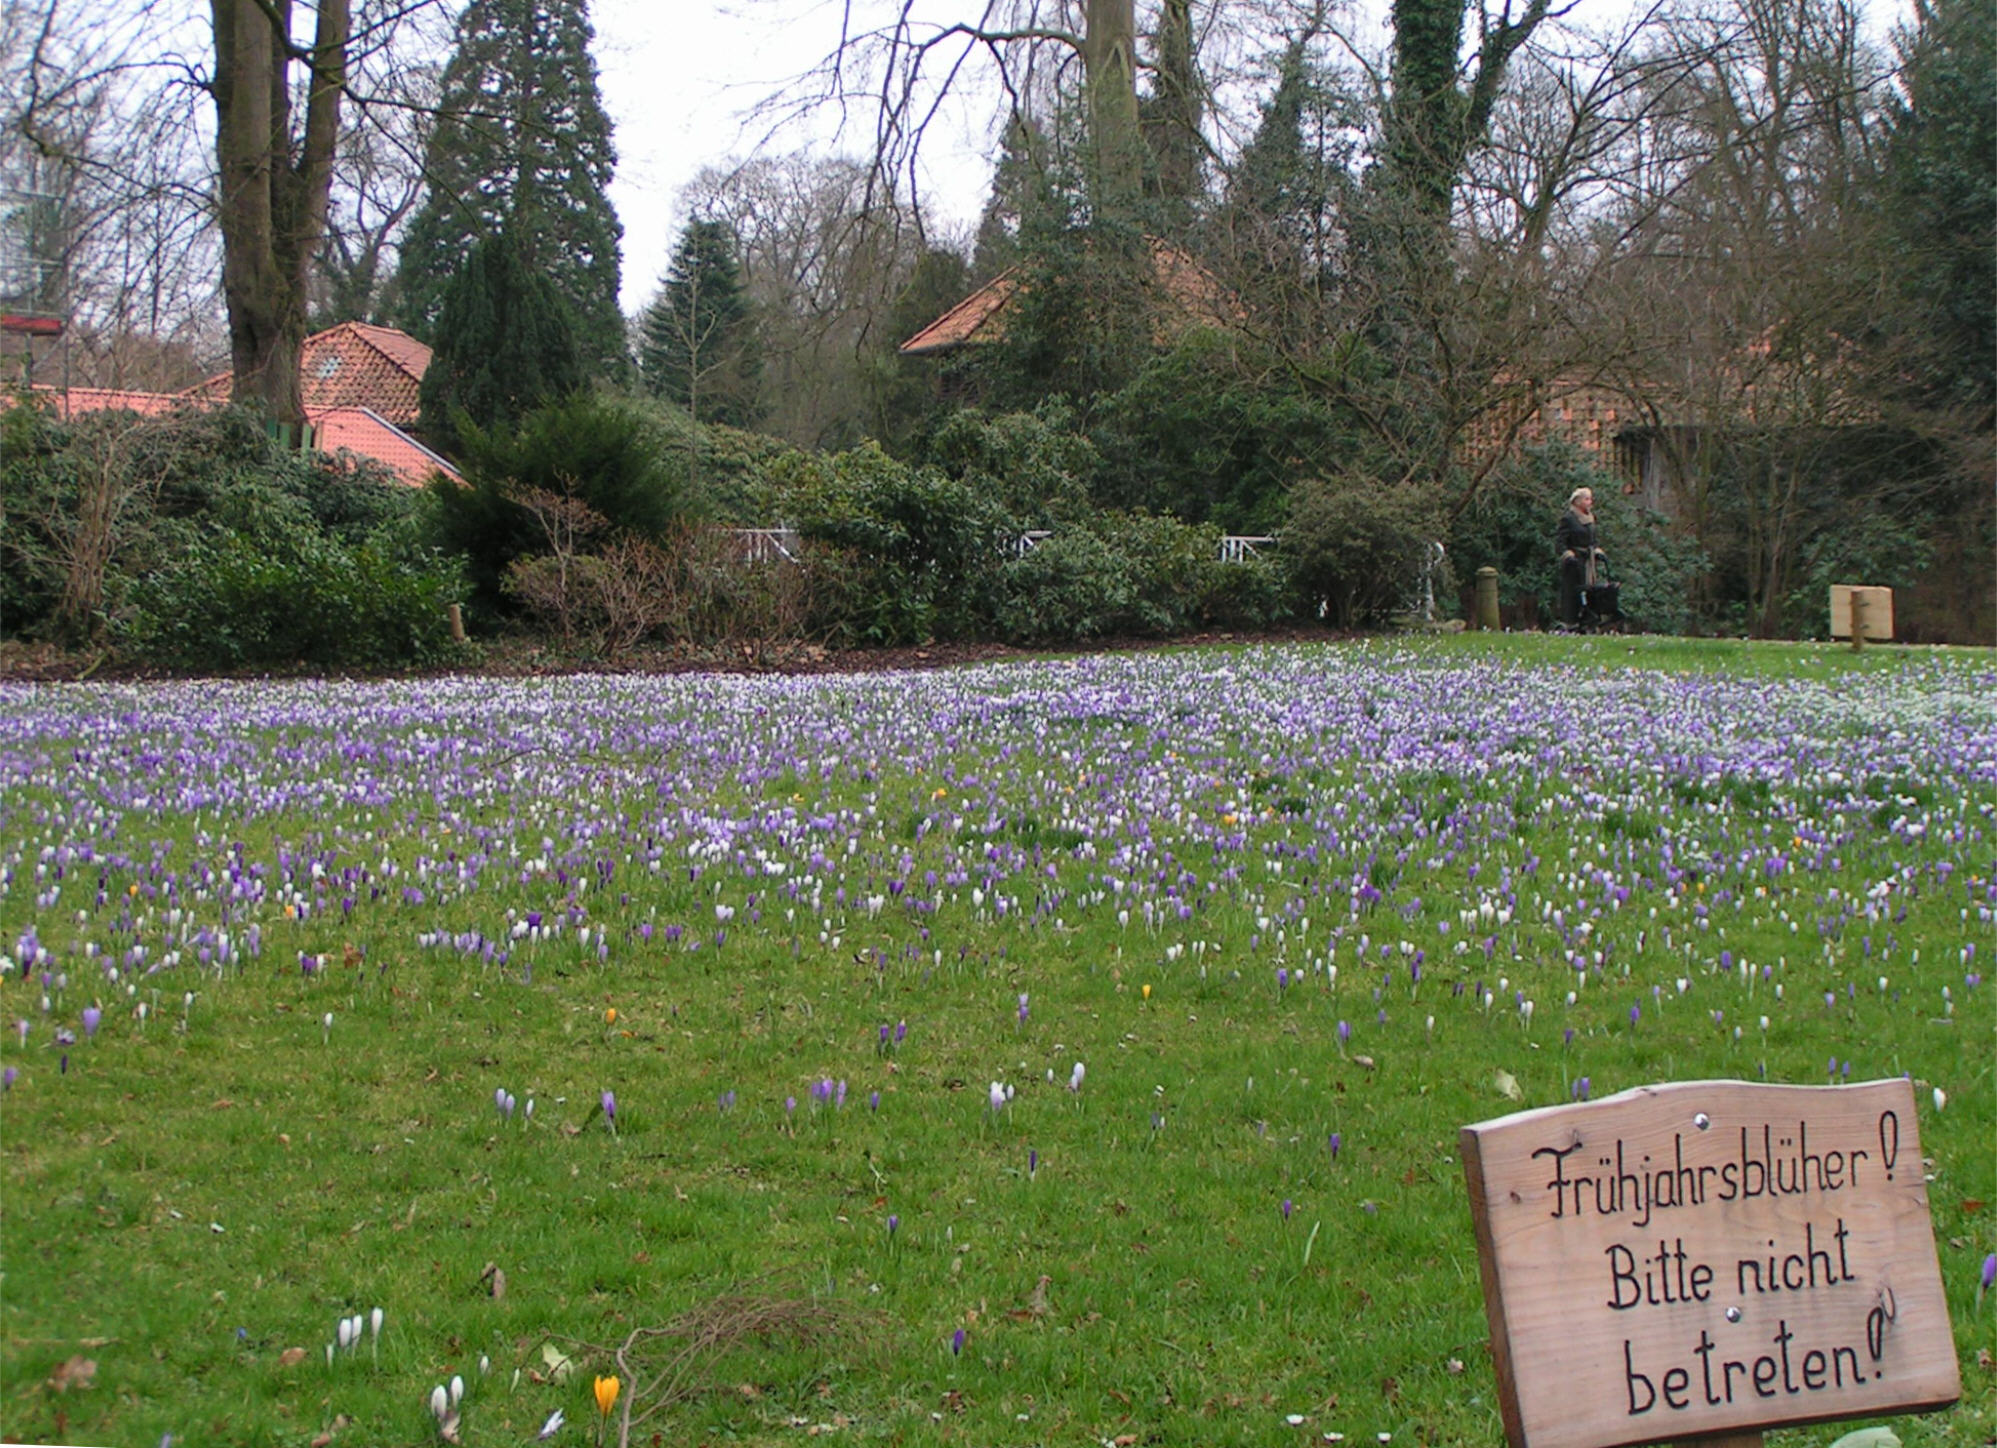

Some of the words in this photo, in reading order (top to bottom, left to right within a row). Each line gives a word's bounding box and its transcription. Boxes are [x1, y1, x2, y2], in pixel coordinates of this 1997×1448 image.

[1605, 1238, 1714, 1310] Bitte
[1737, 1218, 1856, 1295] nicht
[1624, 1305, 1885, 1415] betreten!
